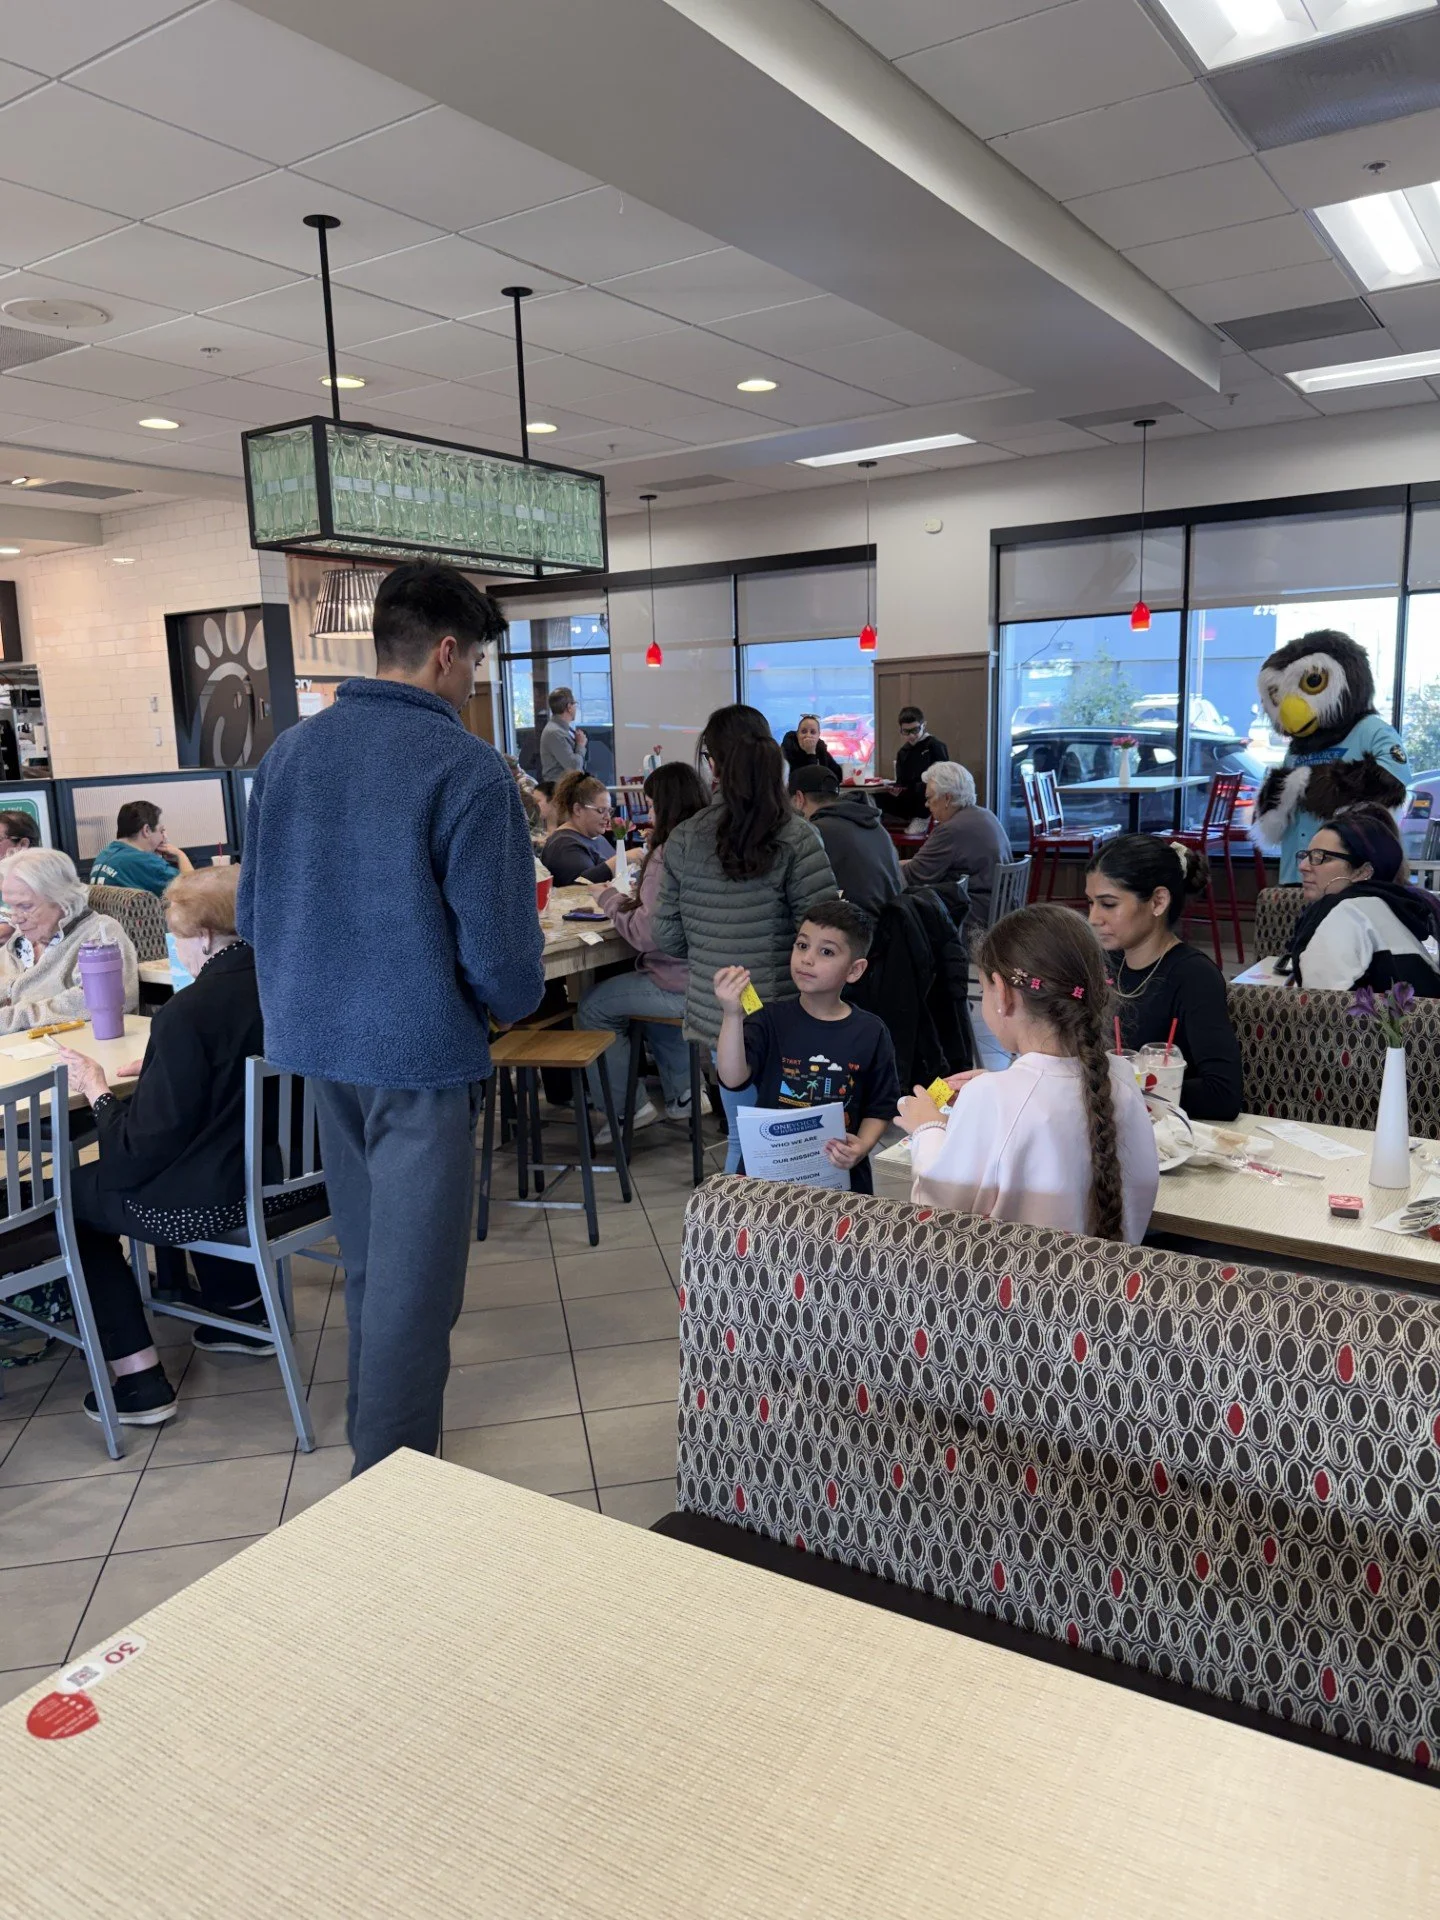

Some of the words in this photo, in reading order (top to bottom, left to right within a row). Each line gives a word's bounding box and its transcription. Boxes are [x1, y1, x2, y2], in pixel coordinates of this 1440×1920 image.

[790, 1150, 820, 1161] MISSION
[796, 1172, 820, 1181] VISION
[105, 1642, 140, 1664] 30
